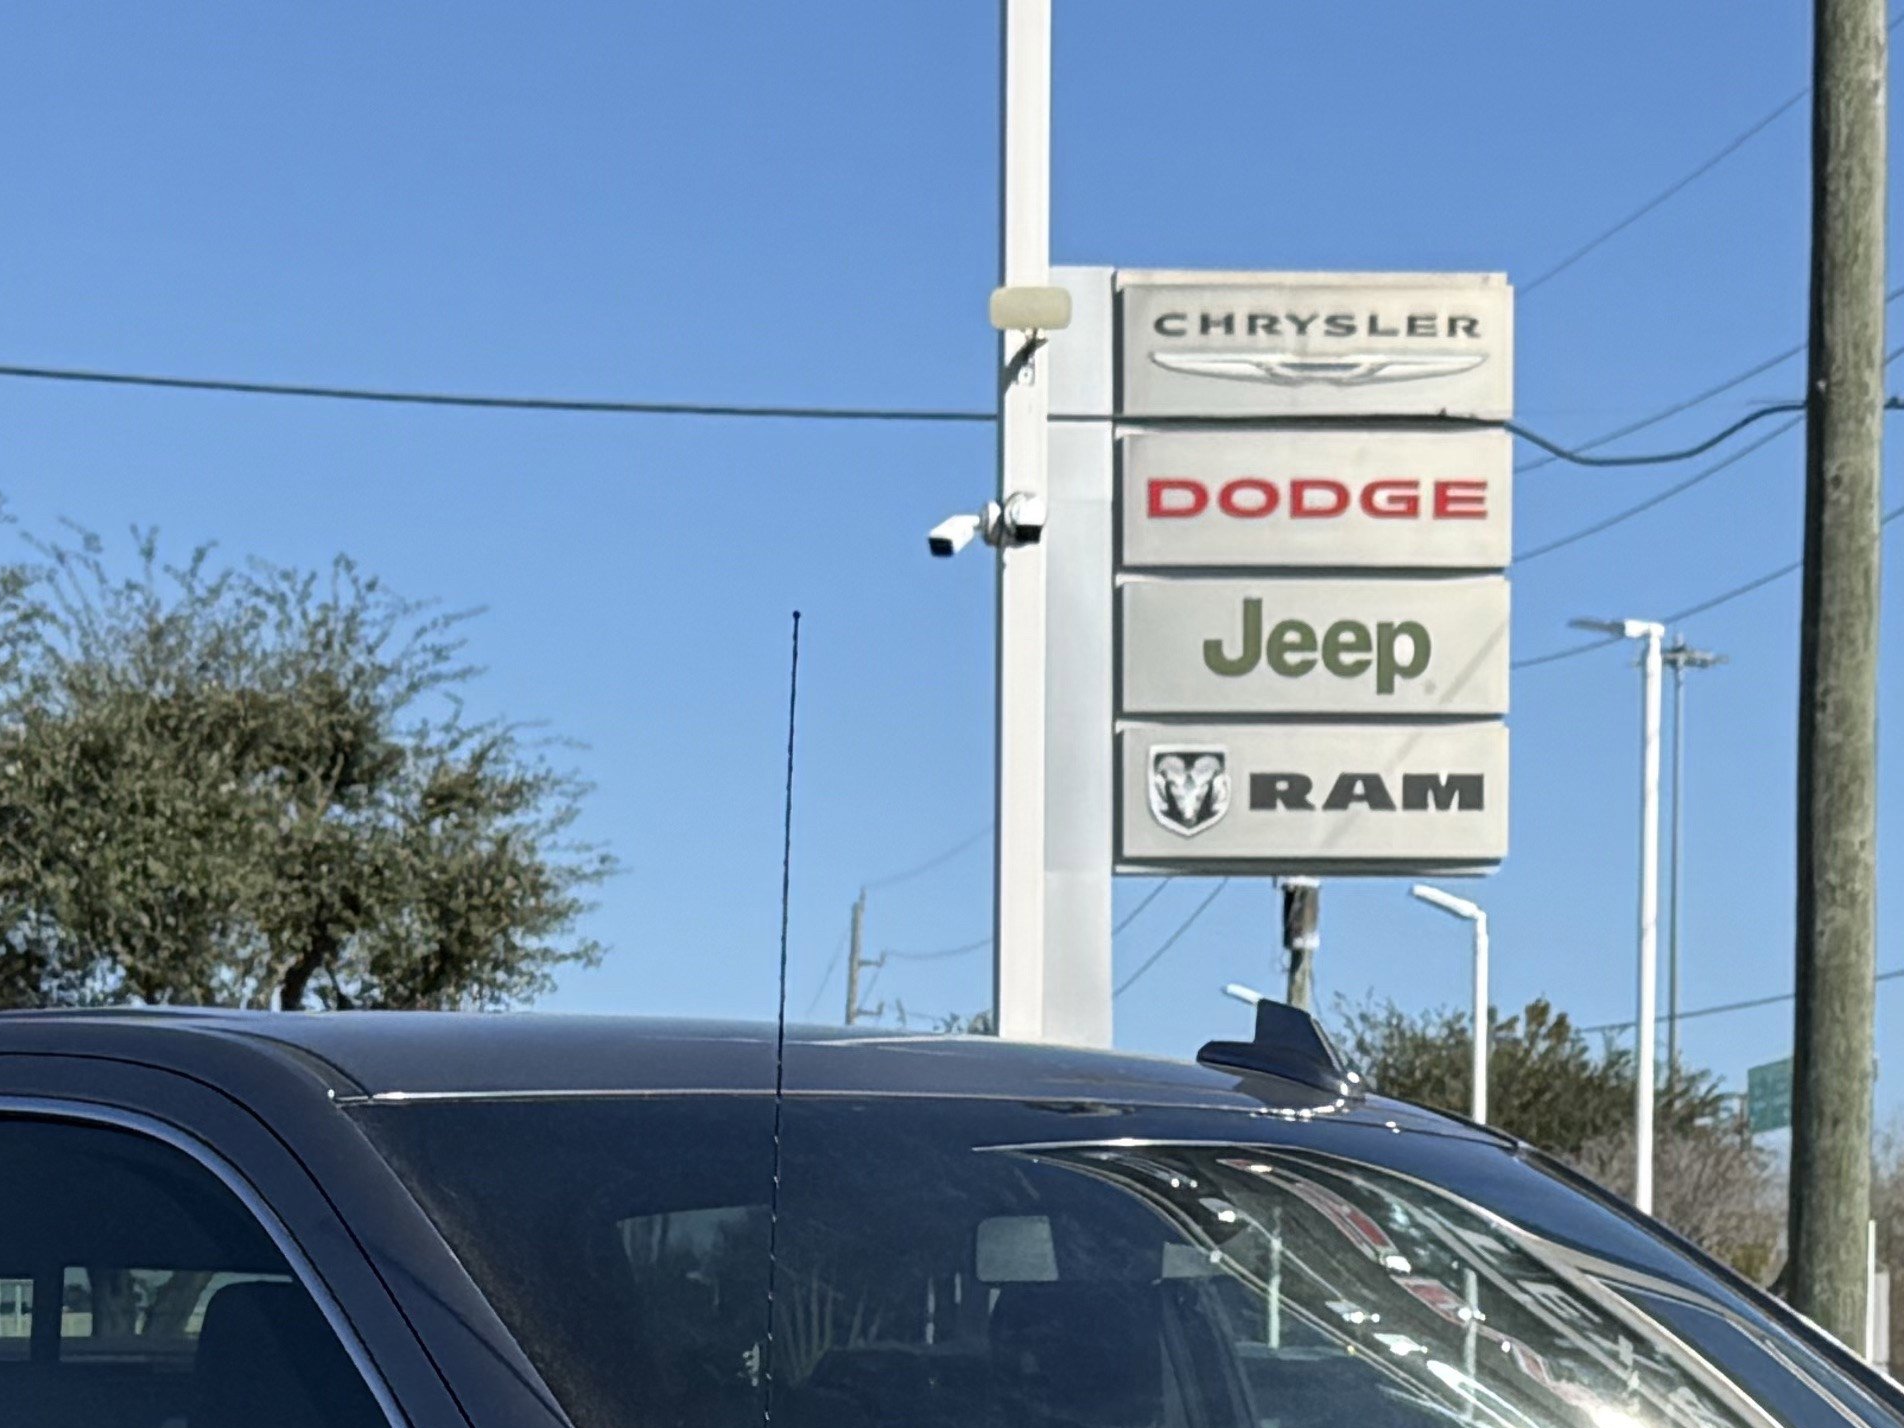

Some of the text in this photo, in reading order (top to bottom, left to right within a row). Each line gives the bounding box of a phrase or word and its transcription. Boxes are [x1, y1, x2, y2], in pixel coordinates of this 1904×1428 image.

[1154, 311, 1482, 339] CHRYSLER
[1146, 478, 1488, 520] DODGE
[1202, 597, 1432, 695] Jeep
[1248, 772, 1485, 811] RAM
